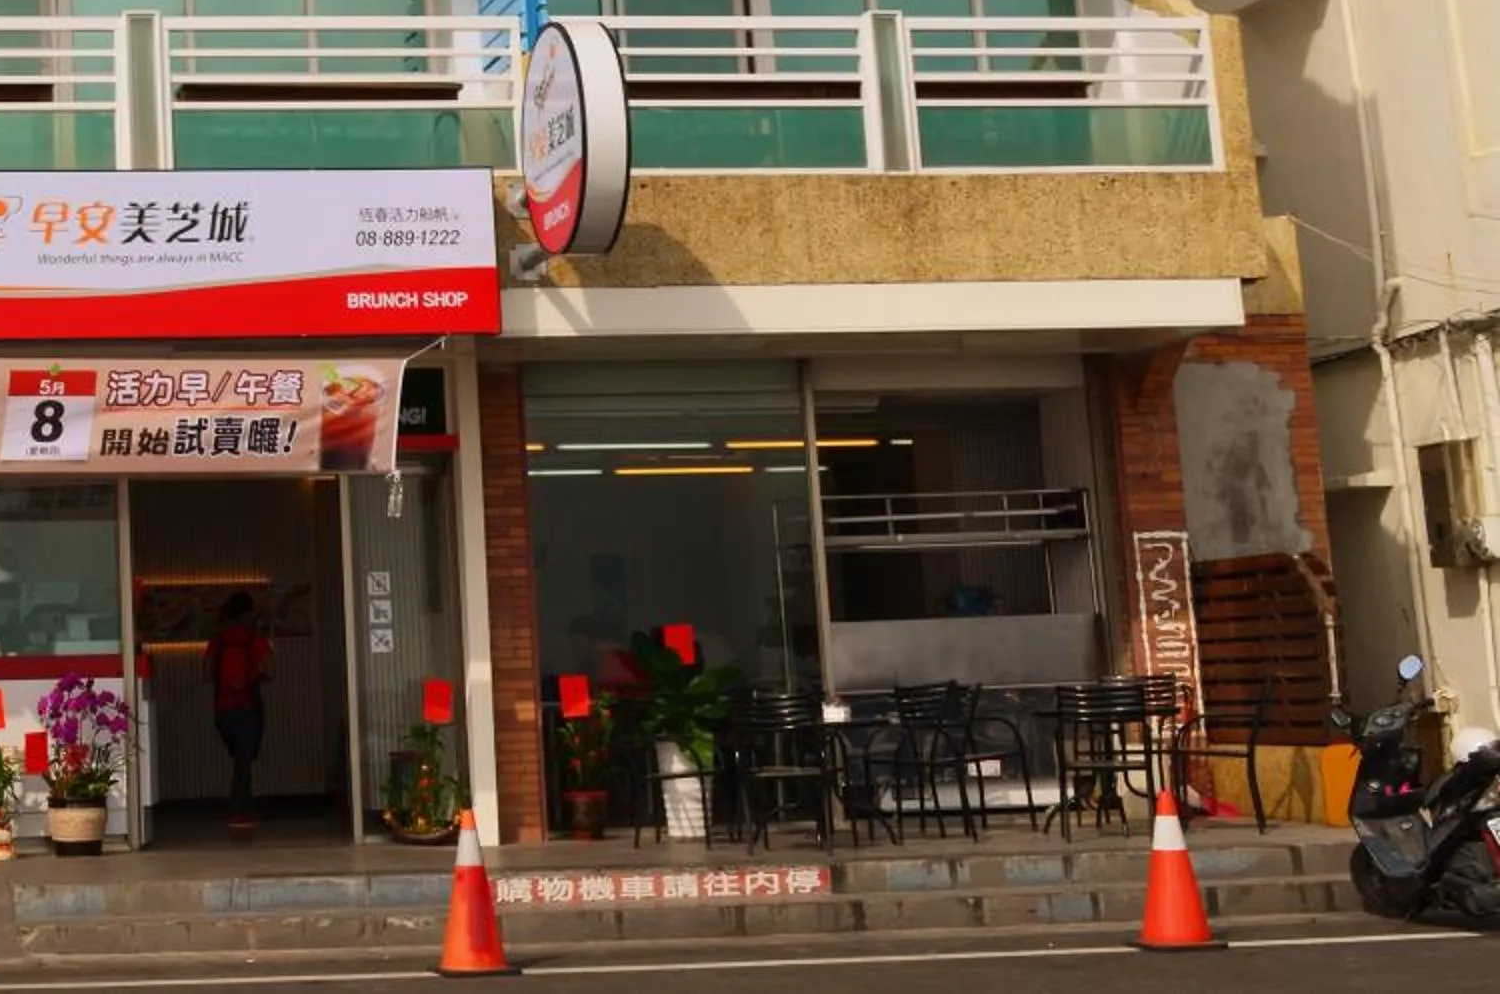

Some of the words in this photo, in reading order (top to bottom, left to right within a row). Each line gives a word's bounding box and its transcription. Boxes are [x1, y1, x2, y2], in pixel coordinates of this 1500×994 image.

[29, 197, 251, 244] 早安美芝城
[37, 253, 96, 265] Wonderful
[100, 253, 133, 266] things
[156, 252, 193, 266] always
[347, 291, 419, 309] BRUNCH
[422, 290, 468, 307] SHOP
[39, 379, 65, 395] 5月
[31, 399, 65, 442] 8
[496, 867, 822, 905] 購物機車請往內停
